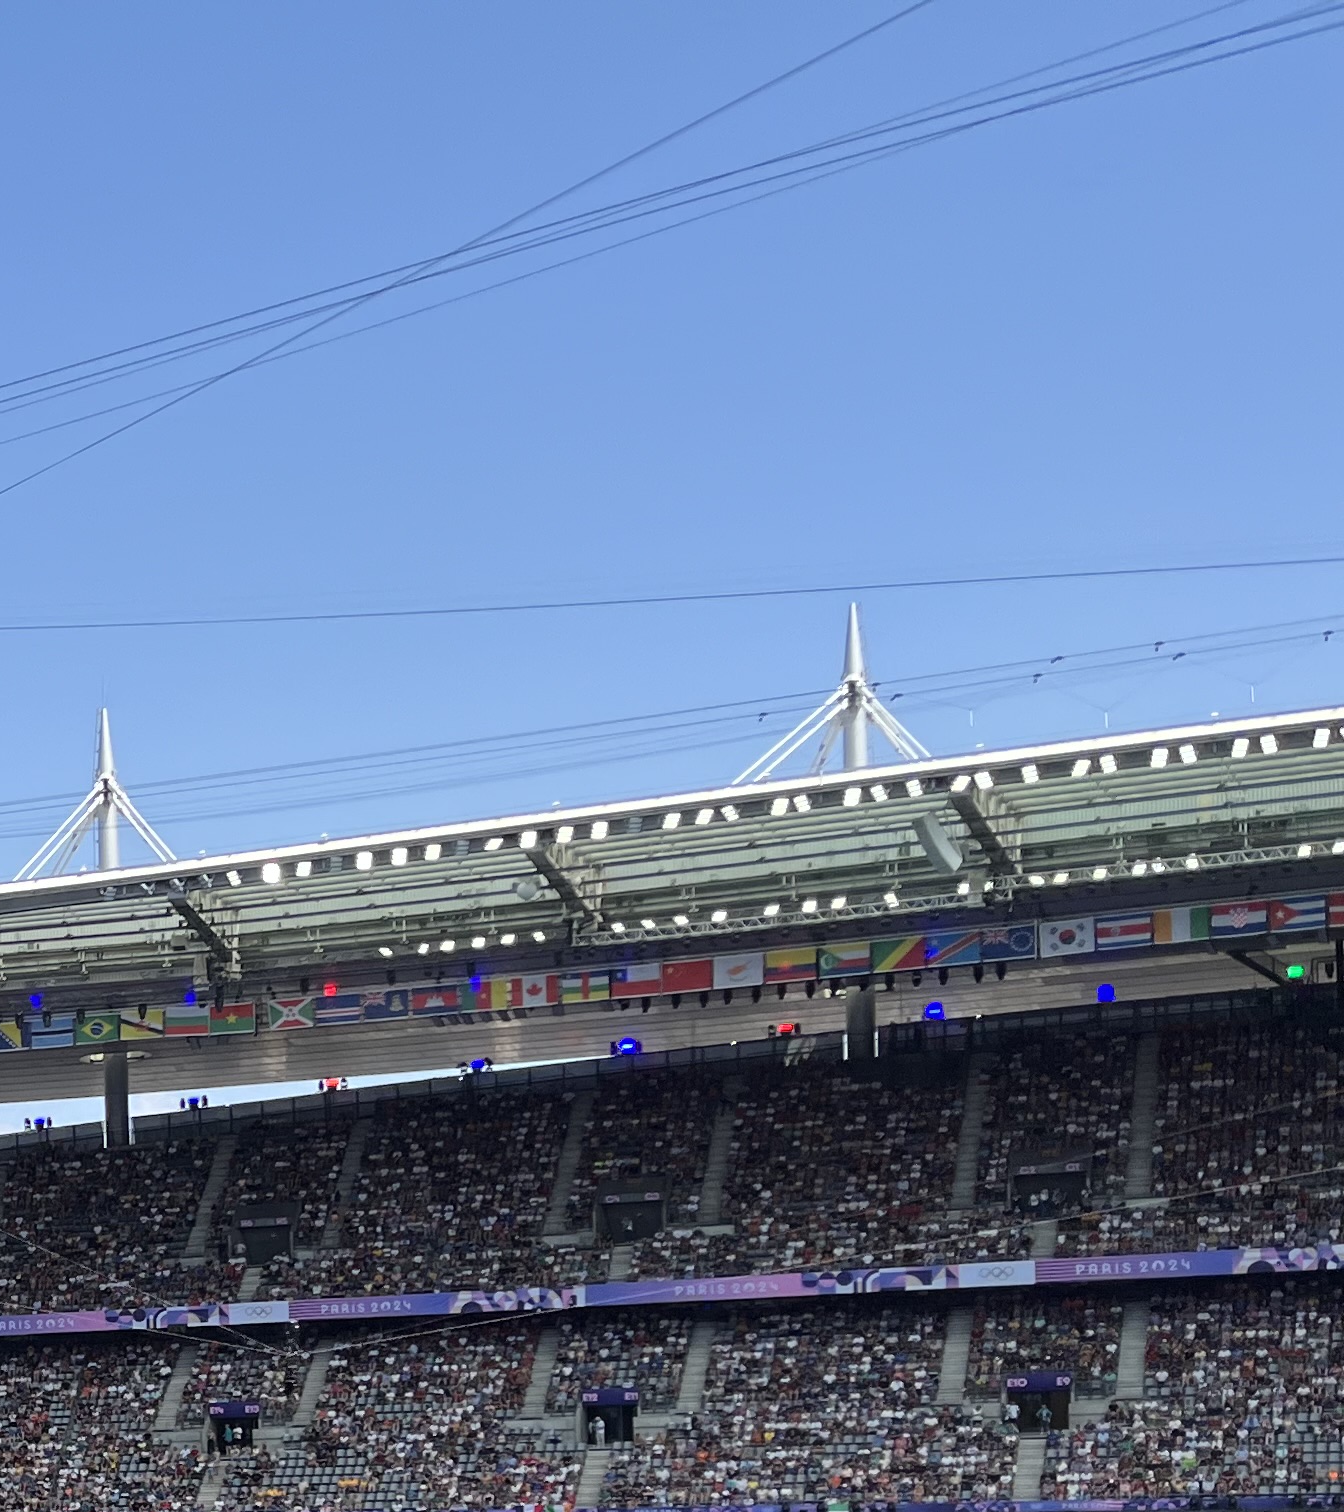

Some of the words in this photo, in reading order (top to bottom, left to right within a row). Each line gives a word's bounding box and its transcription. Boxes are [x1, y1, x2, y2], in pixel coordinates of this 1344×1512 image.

[1139, 1259, 1190, 1273] 2024
[730, 1282, 778, 1294] 2024
[369, 1300, 411, 1313] 2024
[38, 1317, 74, 1330] 2024
